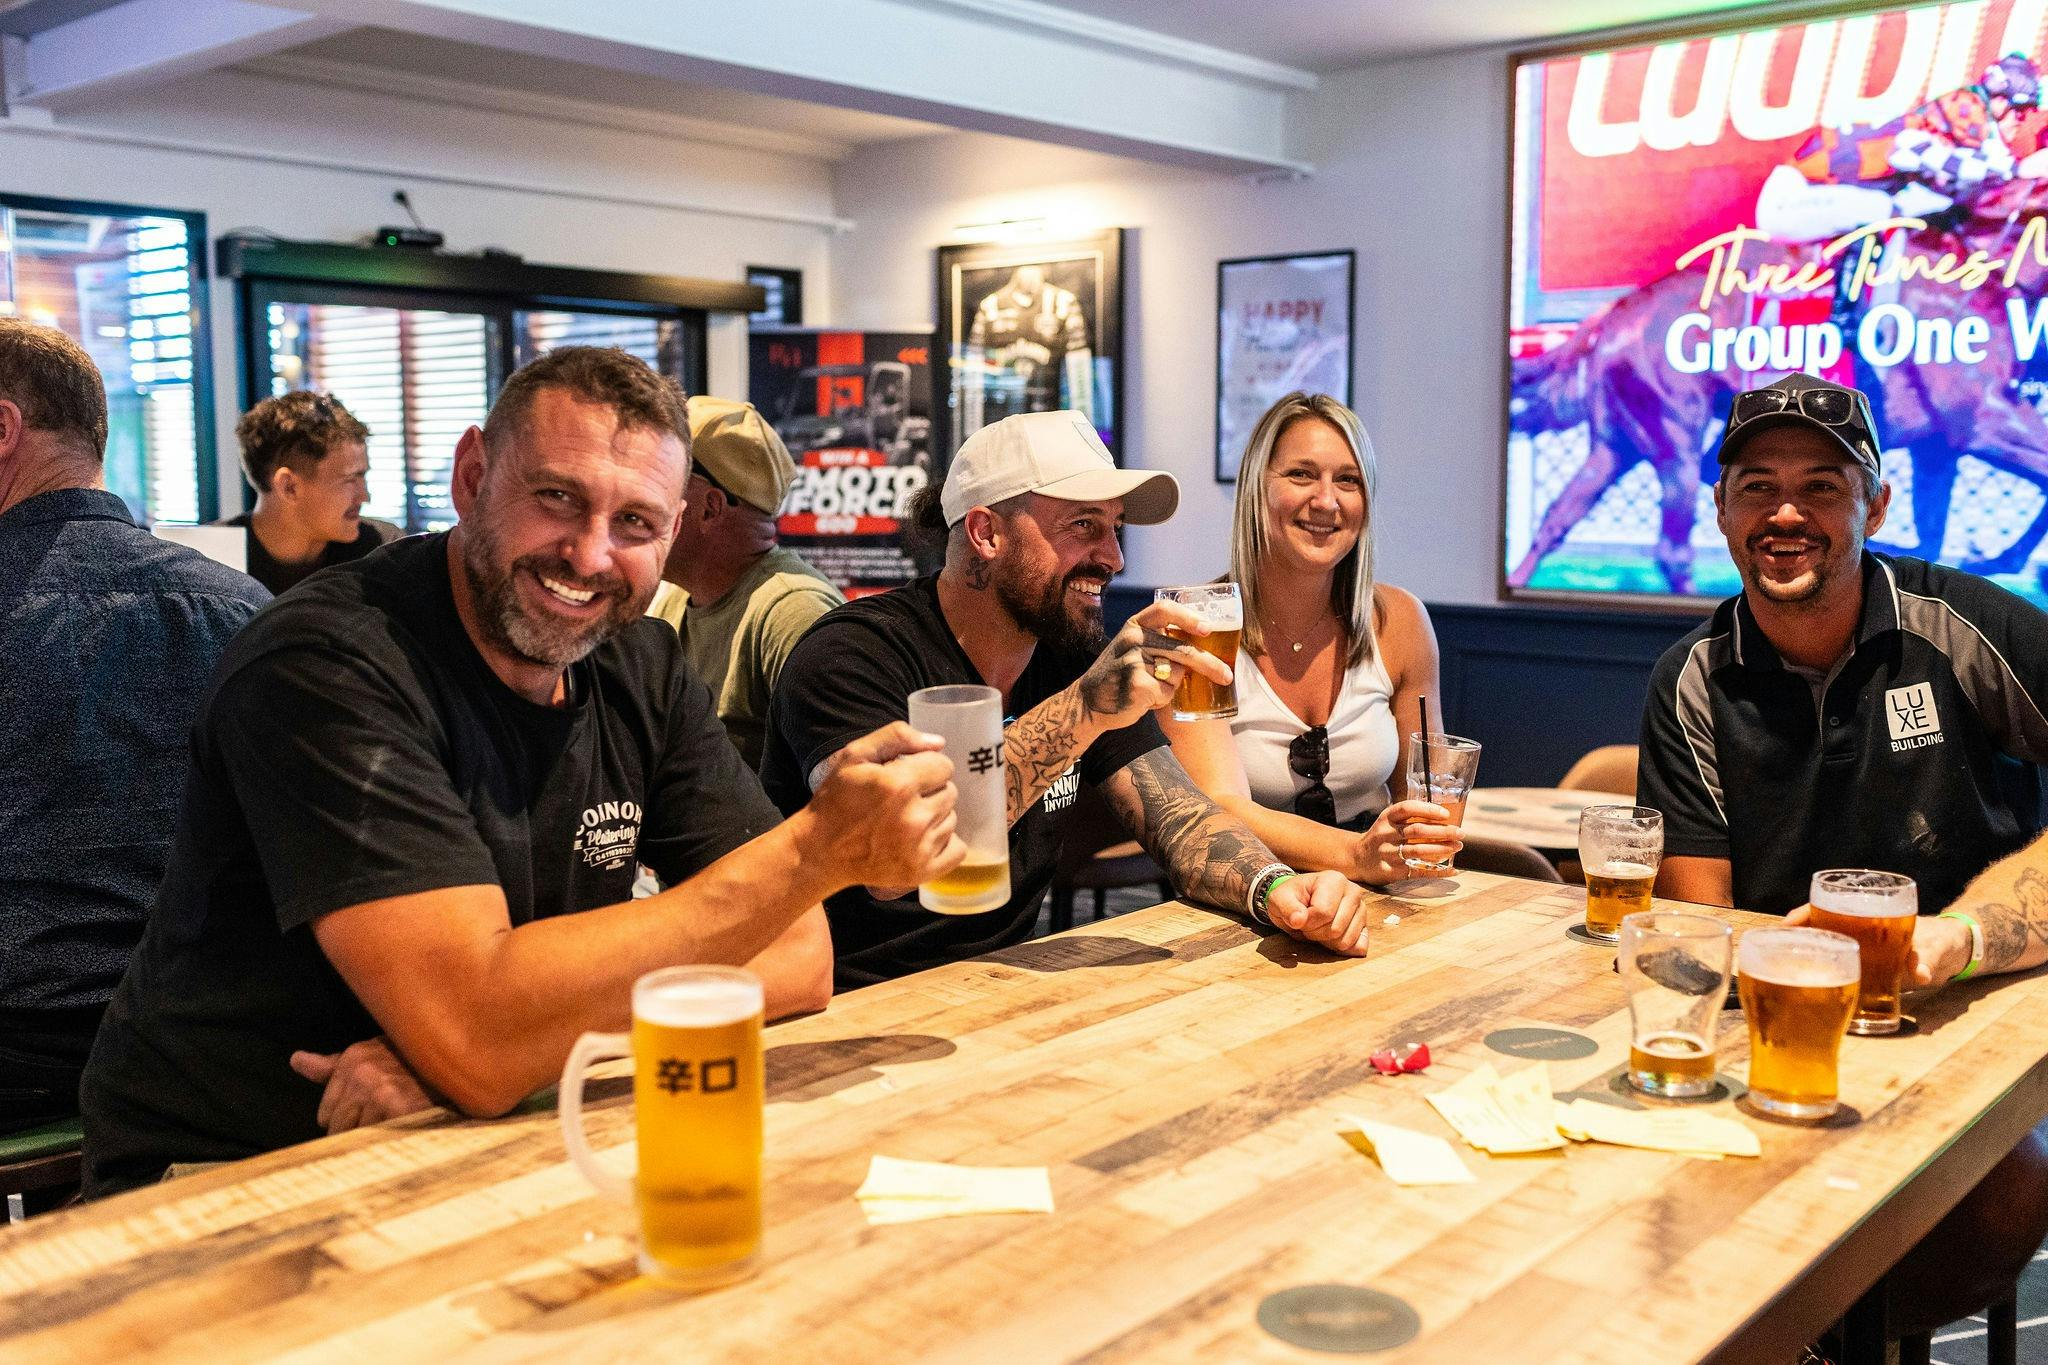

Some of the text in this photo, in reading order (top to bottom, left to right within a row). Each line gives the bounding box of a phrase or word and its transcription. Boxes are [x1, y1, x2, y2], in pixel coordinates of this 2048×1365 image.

[1675, 224, 1834, 310] Three
[1823, 217, 2005, 302] Times
[1665, 312, 1844, 376] Group
[1857, 303, 1990, 367] One
[1890, 732, 1945, 752] BUILDING
[1043, 773, 1081, 801] ANNU
[656, 1057, 738, 1097] 辛口
